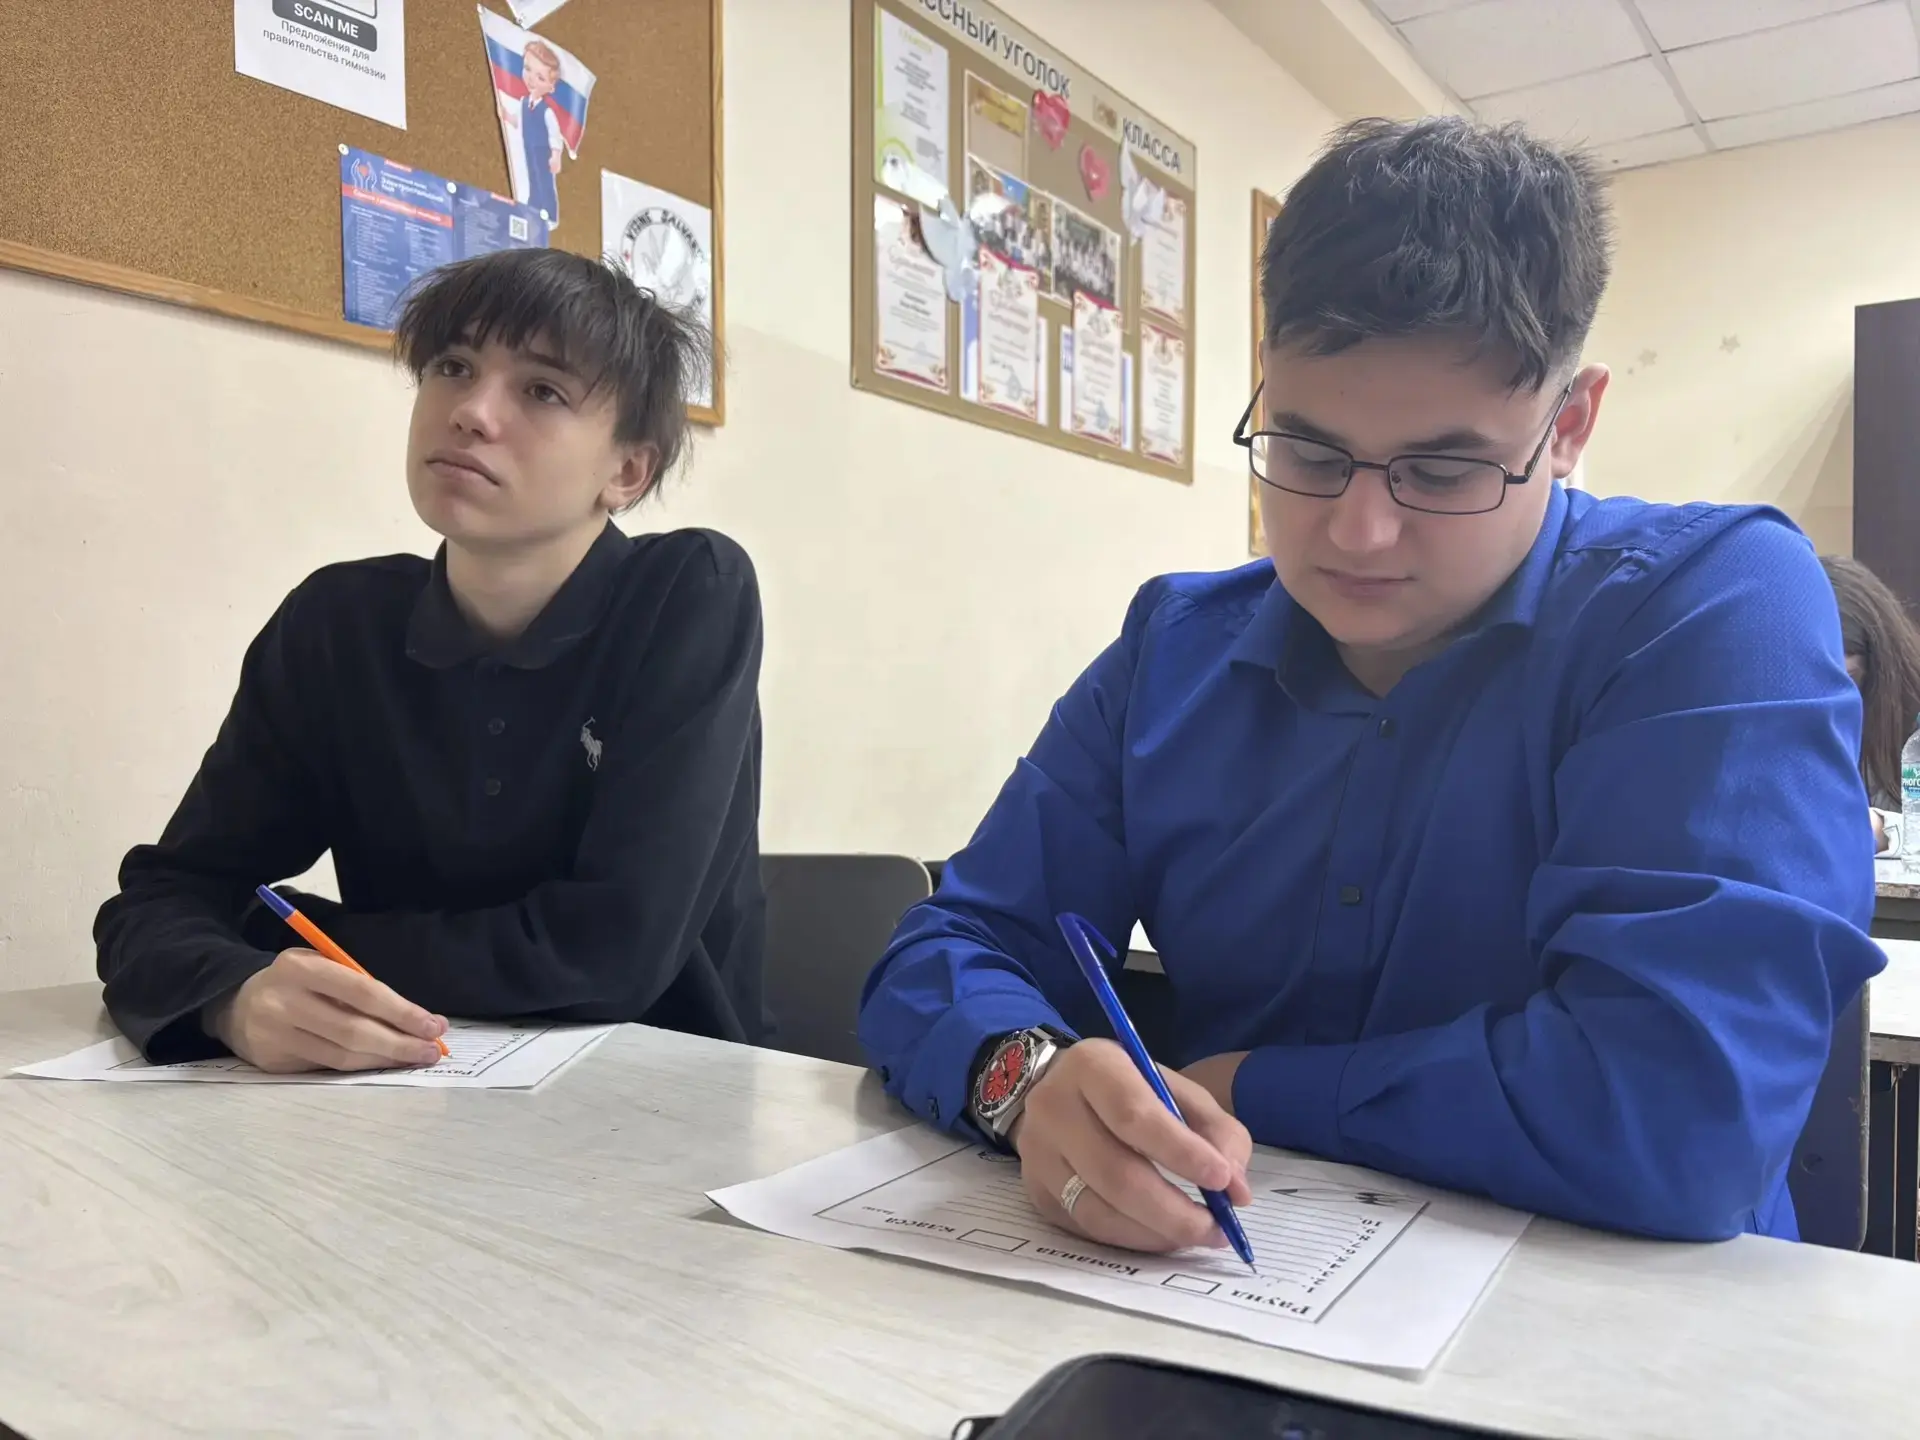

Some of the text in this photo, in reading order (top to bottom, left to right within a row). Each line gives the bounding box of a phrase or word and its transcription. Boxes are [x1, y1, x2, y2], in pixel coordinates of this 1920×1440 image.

[281, 20, 370, 61] Предложения для
[294, 3, 359, 38] SCAN ME
[263, 29, 386, 81] правительства гимназии
[919, 0, 998, 52] ССНЫЙ
[1002, 35, 1072, 98] УГОЛОК
[1123, 117, 1182, 174] КЛАССА
[884, 1217, 1310, 1314] Раунд Команда класса
